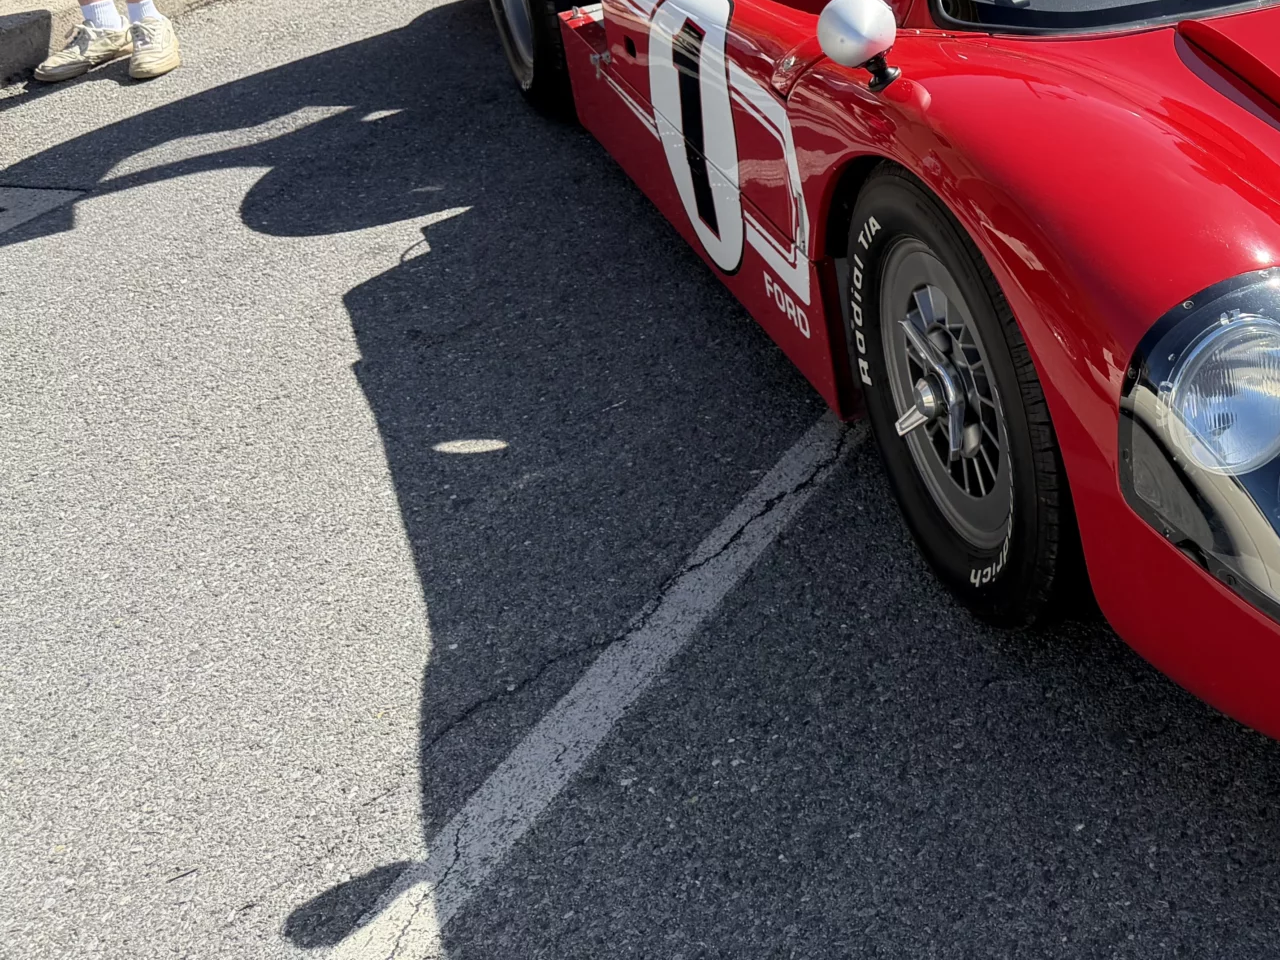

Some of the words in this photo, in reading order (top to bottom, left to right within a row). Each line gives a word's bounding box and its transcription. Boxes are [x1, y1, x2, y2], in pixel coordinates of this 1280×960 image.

[672, 16, 722, 242] 1
[857, 215, 882, 250] T/A
[763, 269, 811, 339] FORD
[850, 253, 873, 387] Radial
